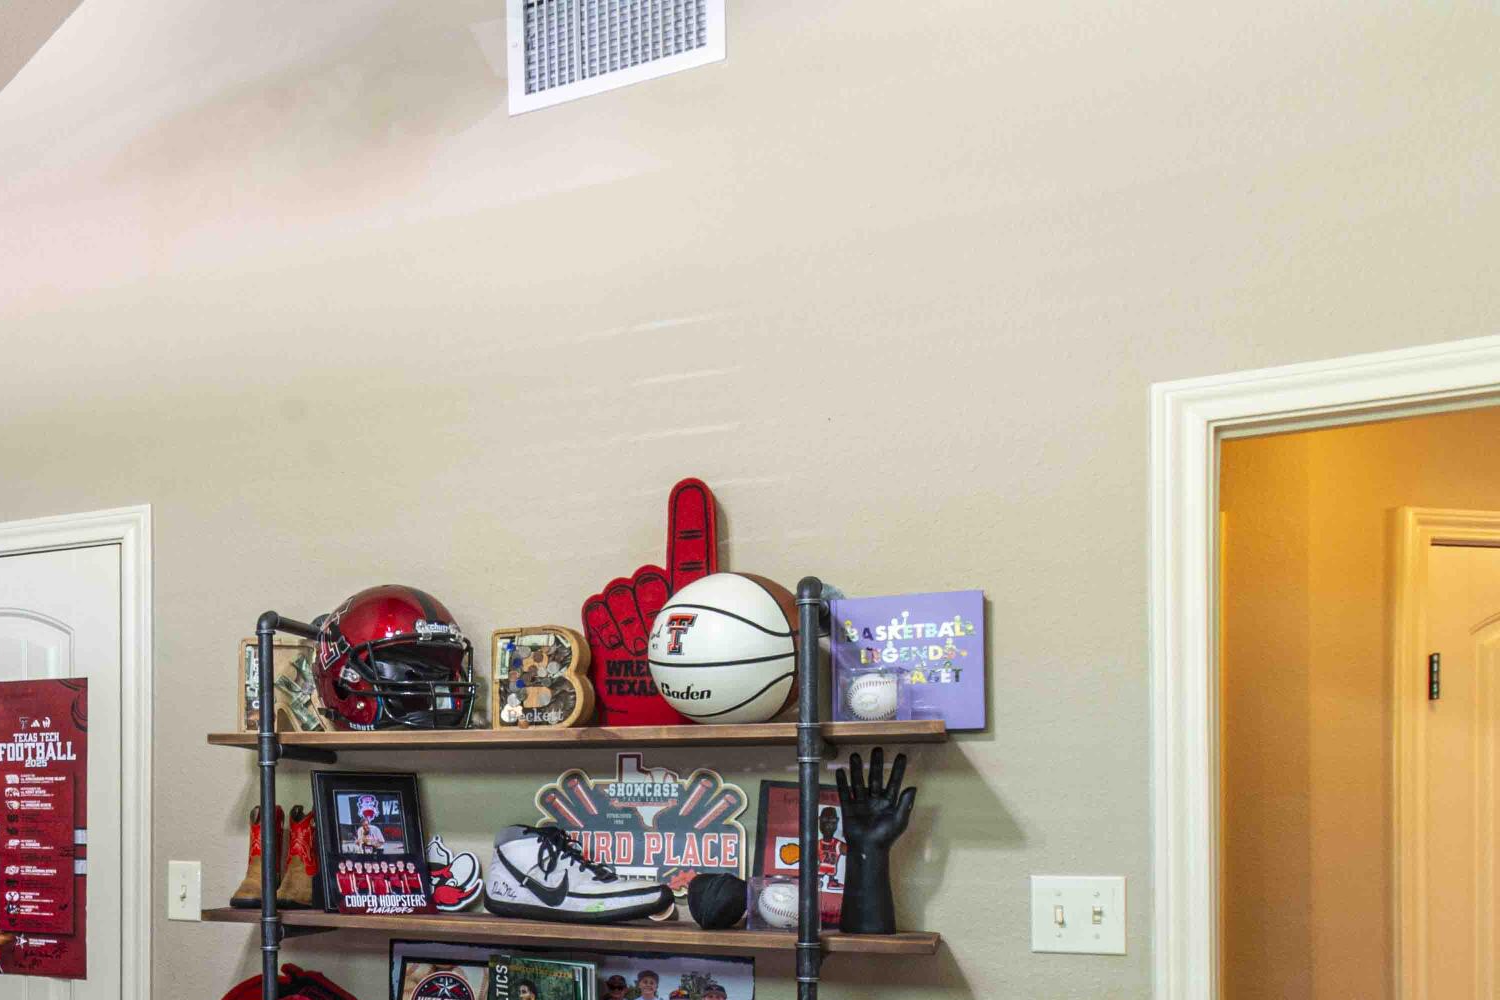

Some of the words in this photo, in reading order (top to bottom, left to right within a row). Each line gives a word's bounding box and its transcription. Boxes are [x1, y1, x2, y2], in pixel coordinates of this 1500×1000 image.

[661, 682, 711, 700] Baden
[13, 733, 38, 743] TEXAS
[40, 732, 60, 742] TECH
[25, 759, 47, 767] 2025
[609, 783, 679, 797] SHOWCASE
[643, 832, 738, 867] PLACE
[345, 894, 378, 908] COOPER
[379, 894, 427, 907] HOOPSTERS
